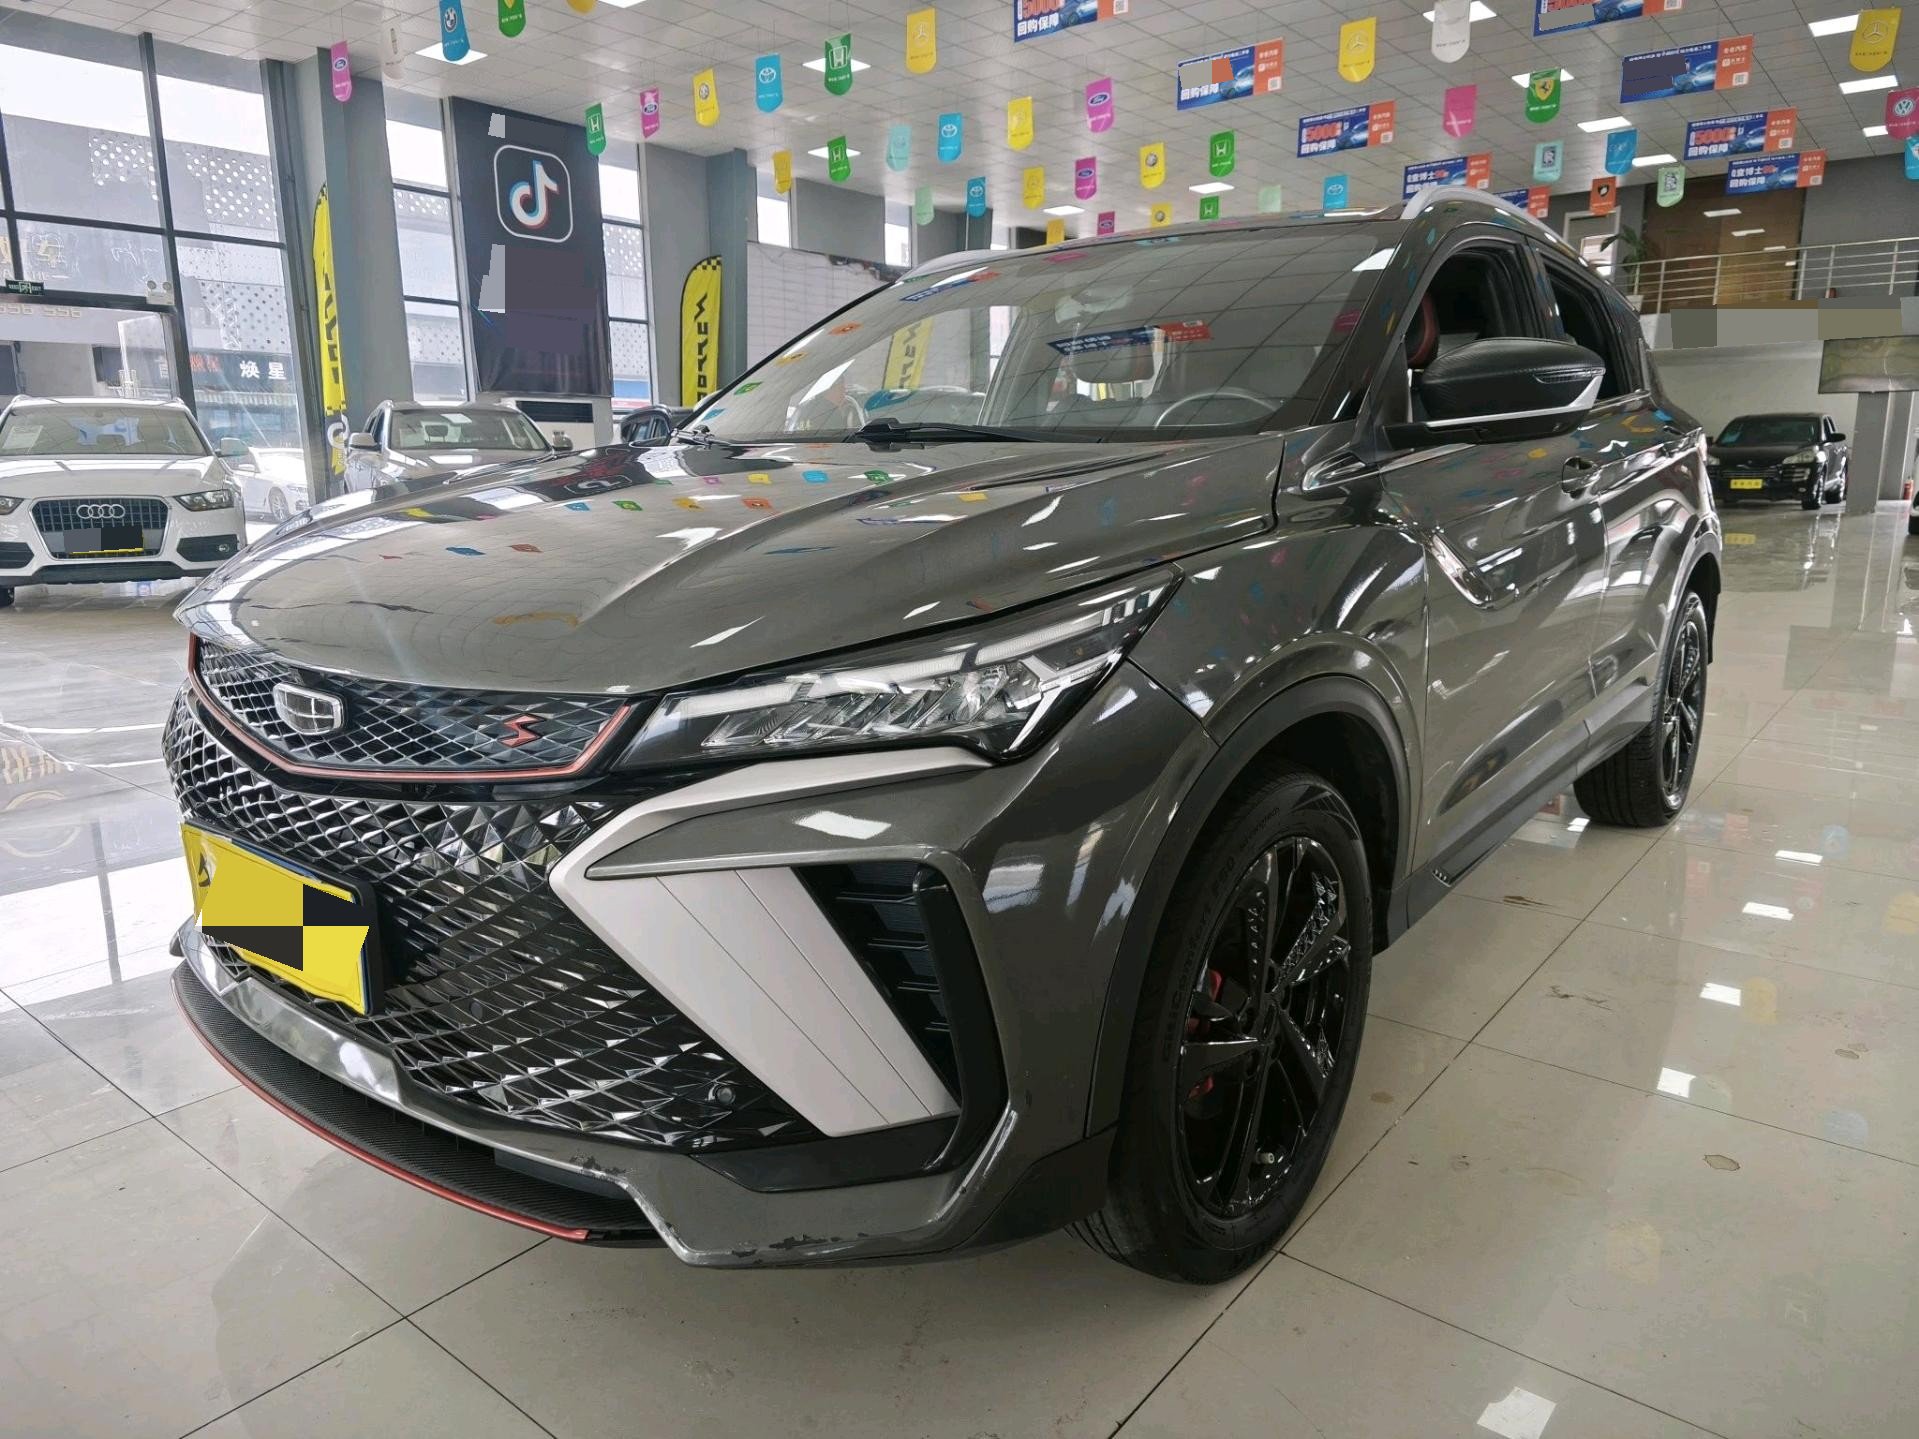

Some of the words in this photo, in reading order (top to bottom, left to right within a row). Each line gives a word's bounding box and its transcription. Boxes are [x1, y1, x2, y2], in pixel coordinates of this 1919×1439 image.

[1017, 12, 1060, 37] 回购保障
[239, 360, 287, 381] 焕星
